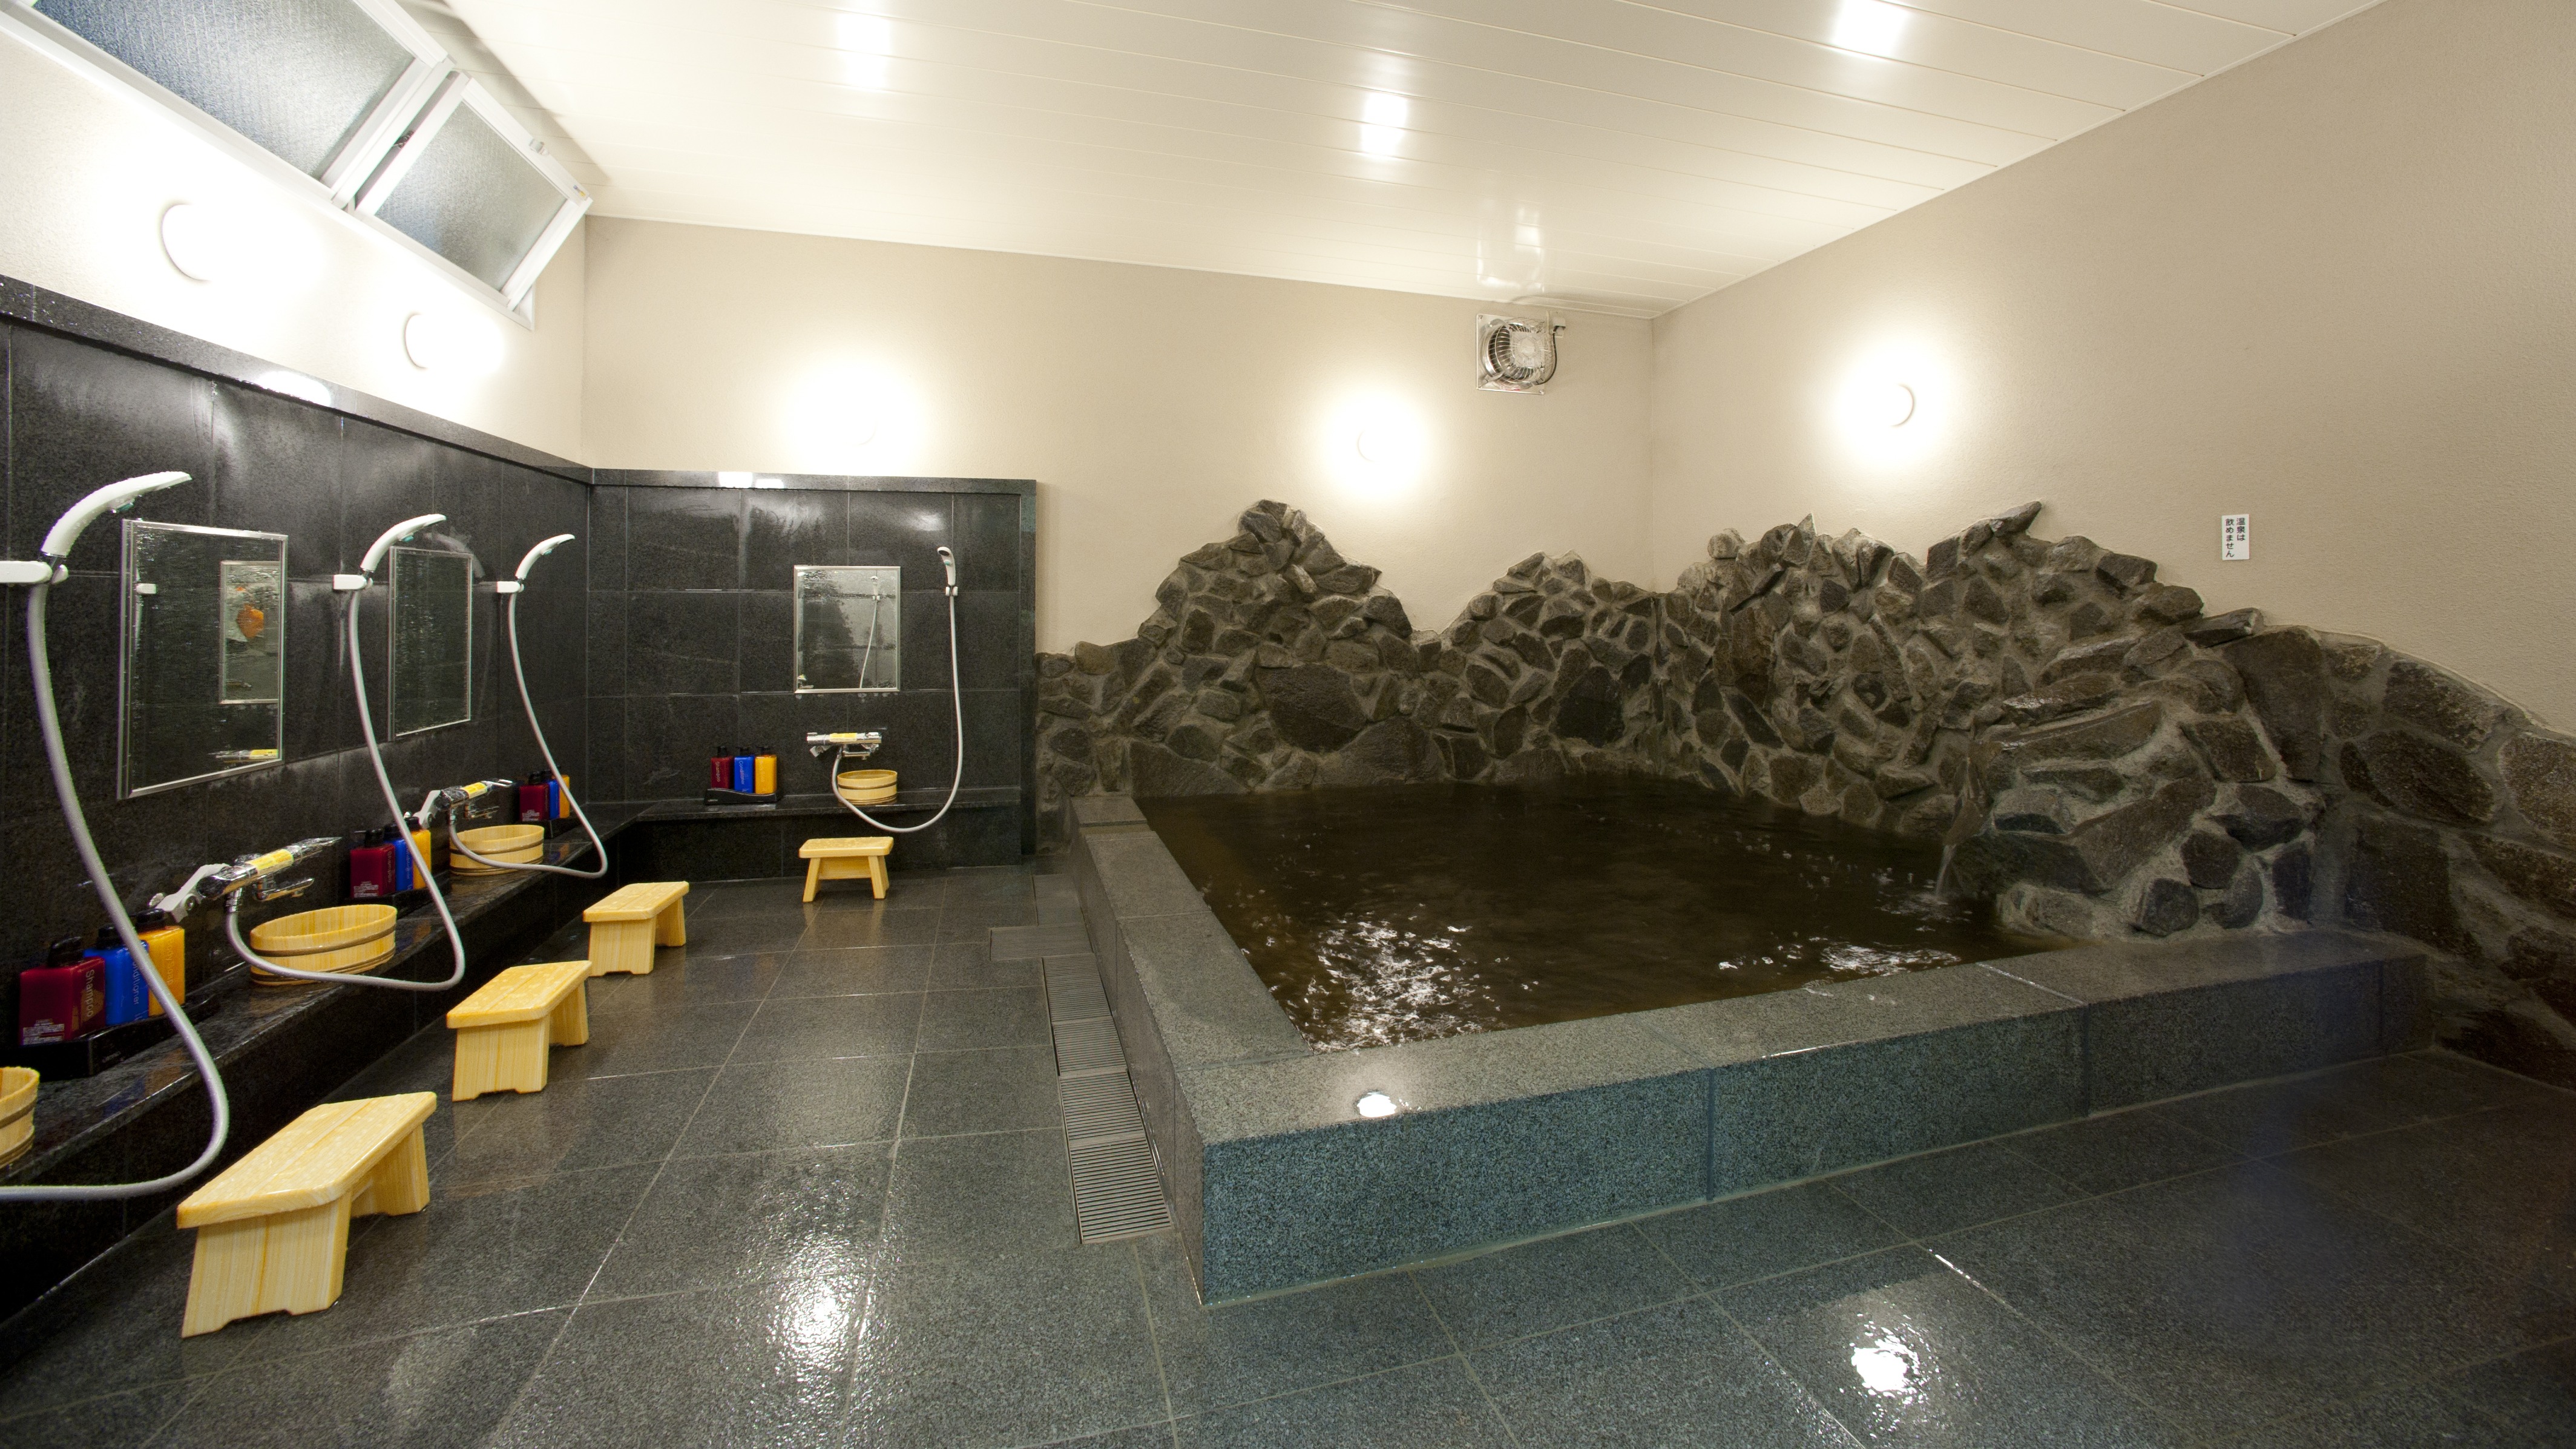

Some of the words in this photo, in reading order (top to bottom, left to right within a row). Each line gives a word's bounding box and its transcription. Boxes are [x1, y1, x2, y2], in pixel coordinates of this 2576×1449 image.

[2226, 518, 2235, 557] 飲めません
[2236, 518, 2246, 541] 温泉は
[85, 969, 95, 1017] Shampoo
